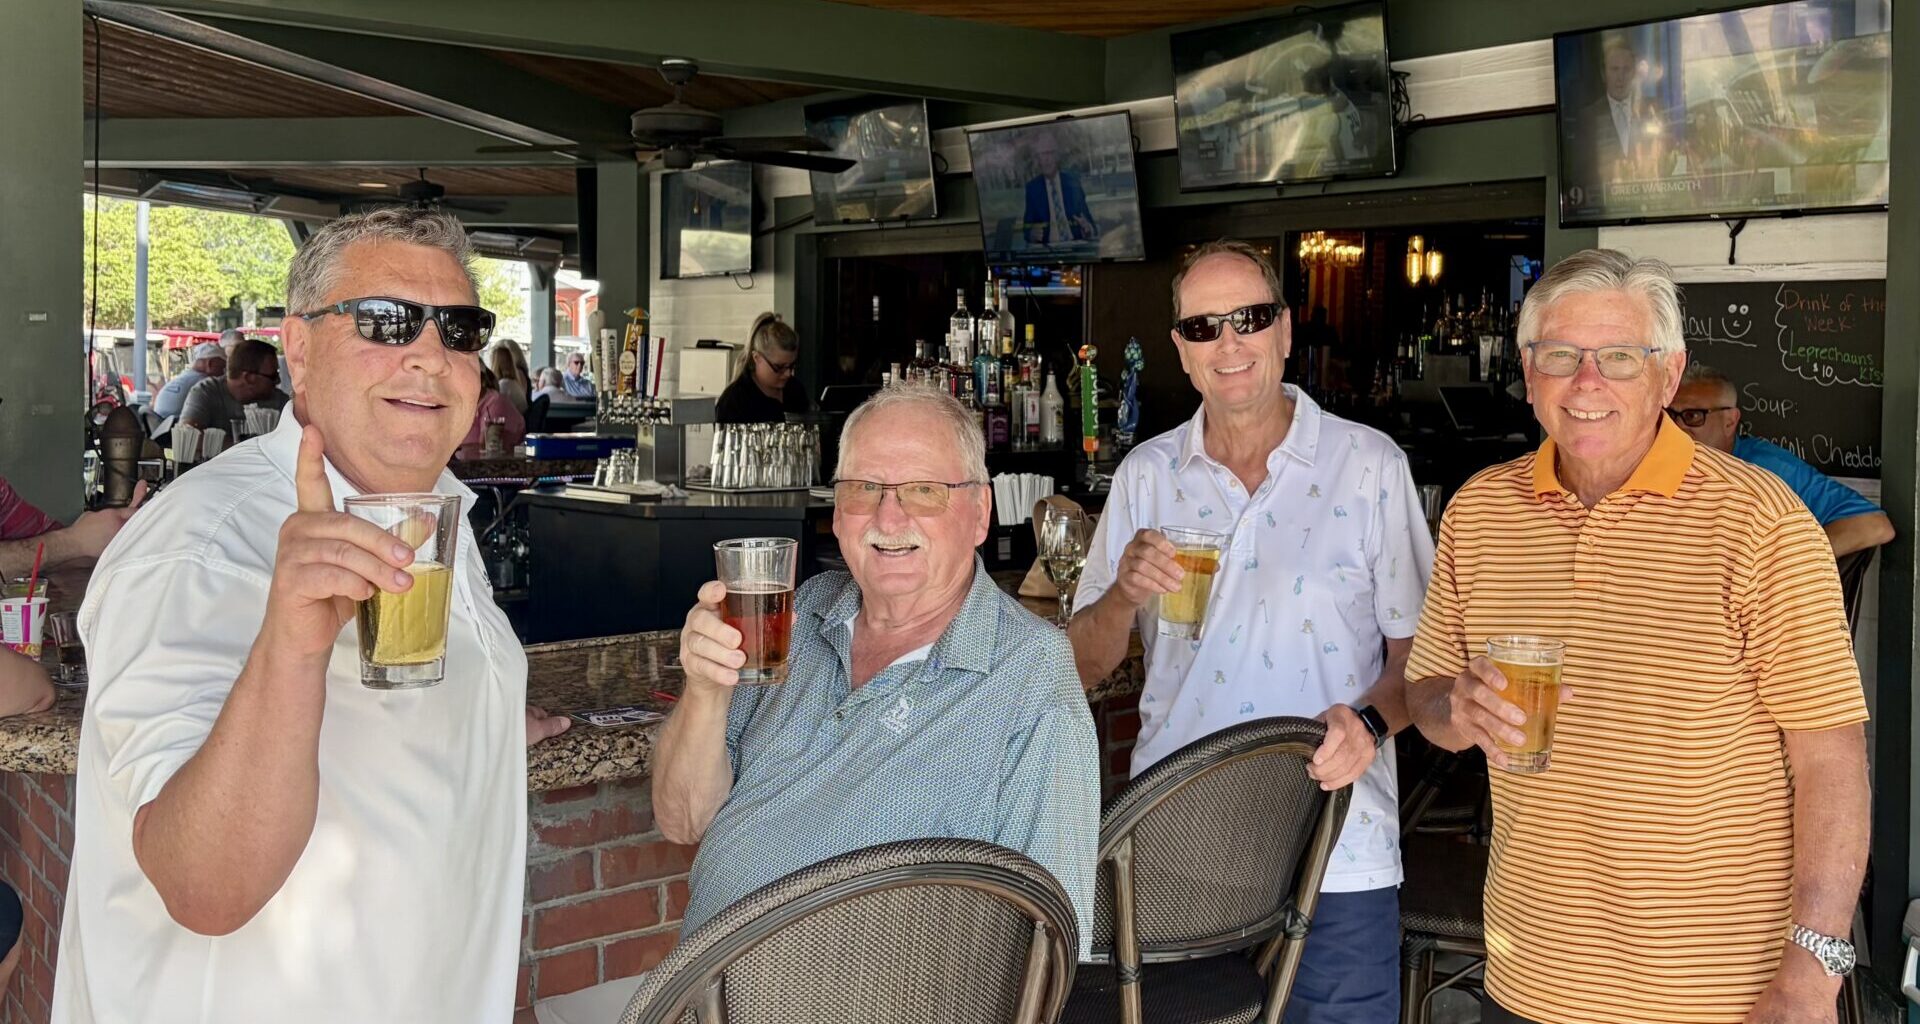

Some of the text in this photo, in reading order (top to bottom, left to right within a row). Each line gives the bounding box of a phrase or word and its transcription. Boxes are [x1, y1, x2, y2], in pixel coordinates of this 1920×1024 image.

[1569, 186, 1584, 205] 9
[1611, 180, 1701, 195] GREG WARMOTH
[1784, 289, 1831, 311] Drink
[1840, 293, 1855, 311] of
[1742, 383, 1799, 418] Soup:
